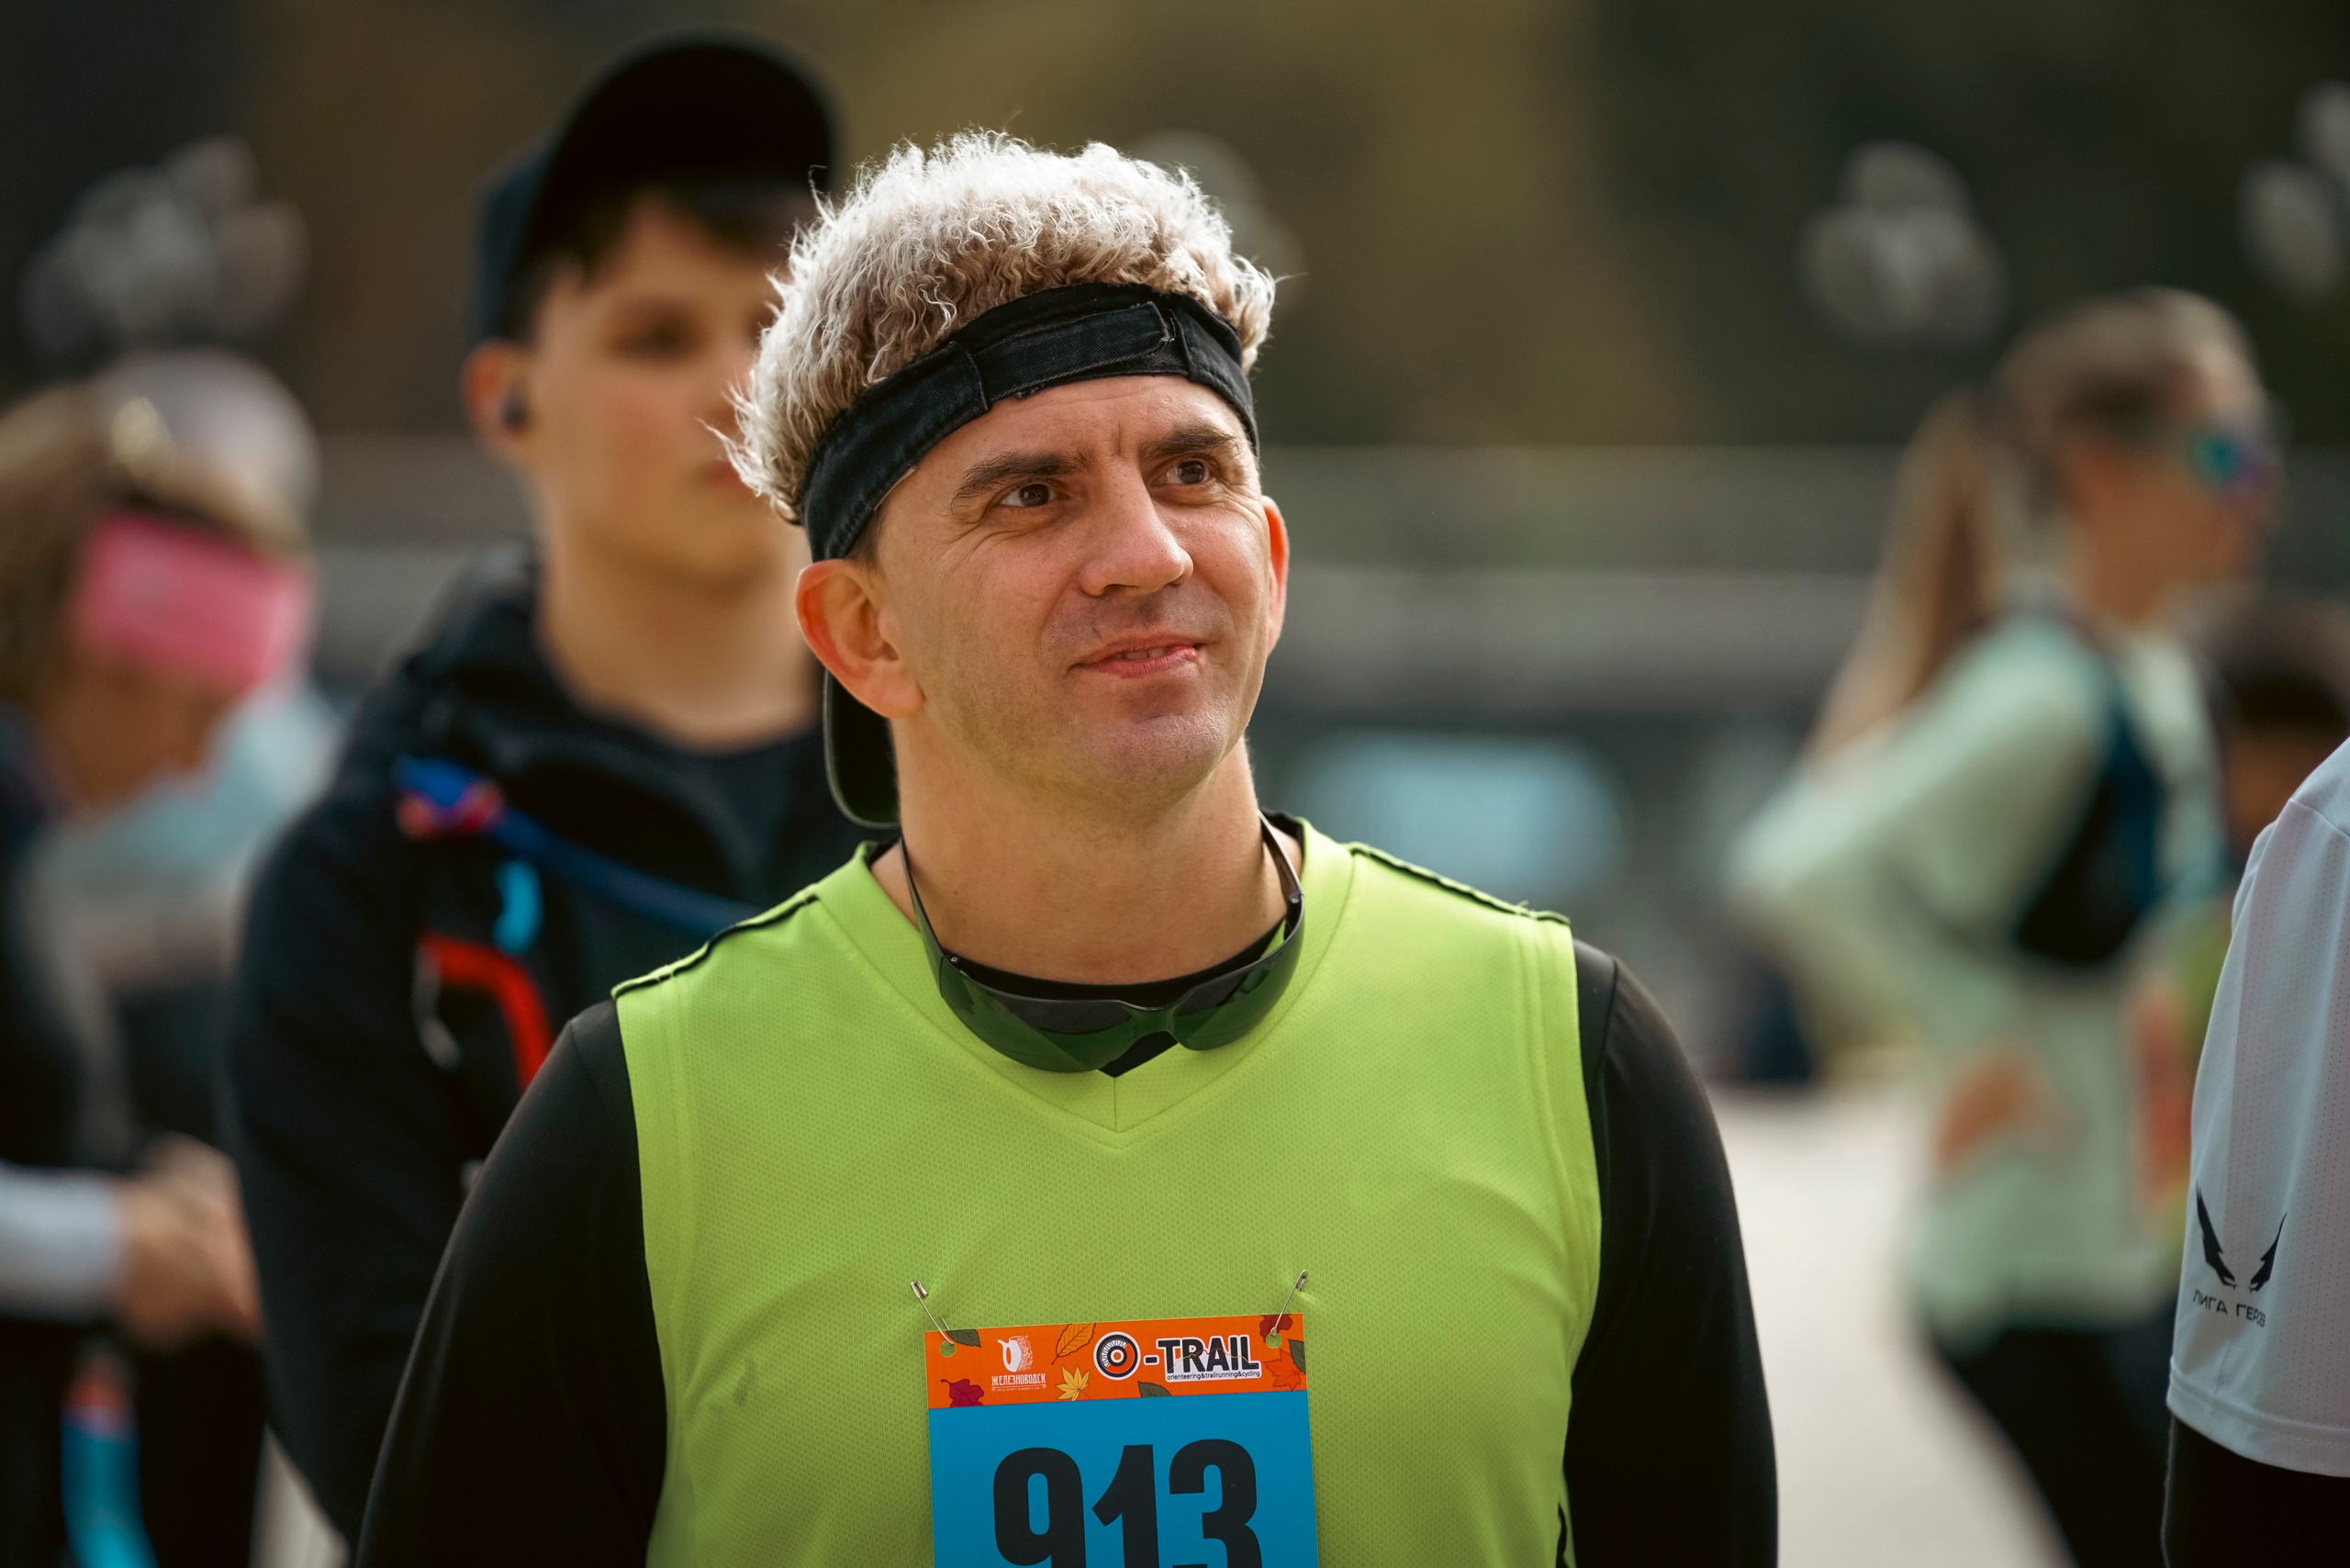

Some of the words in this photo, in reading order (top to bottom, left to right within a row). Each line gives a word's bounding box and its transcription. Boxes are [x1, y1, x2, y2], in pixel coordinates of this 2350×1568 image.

[2193, 1290, 2228, 1315] ЛИГА
[991, 1373, 1046, 1386] ЖЕЛЕЗНОВОДСК
[1167, 1371, 1260, 1381] orienteering&trailrunning&cycling
[993, 1439, 1263, 1568] 913
